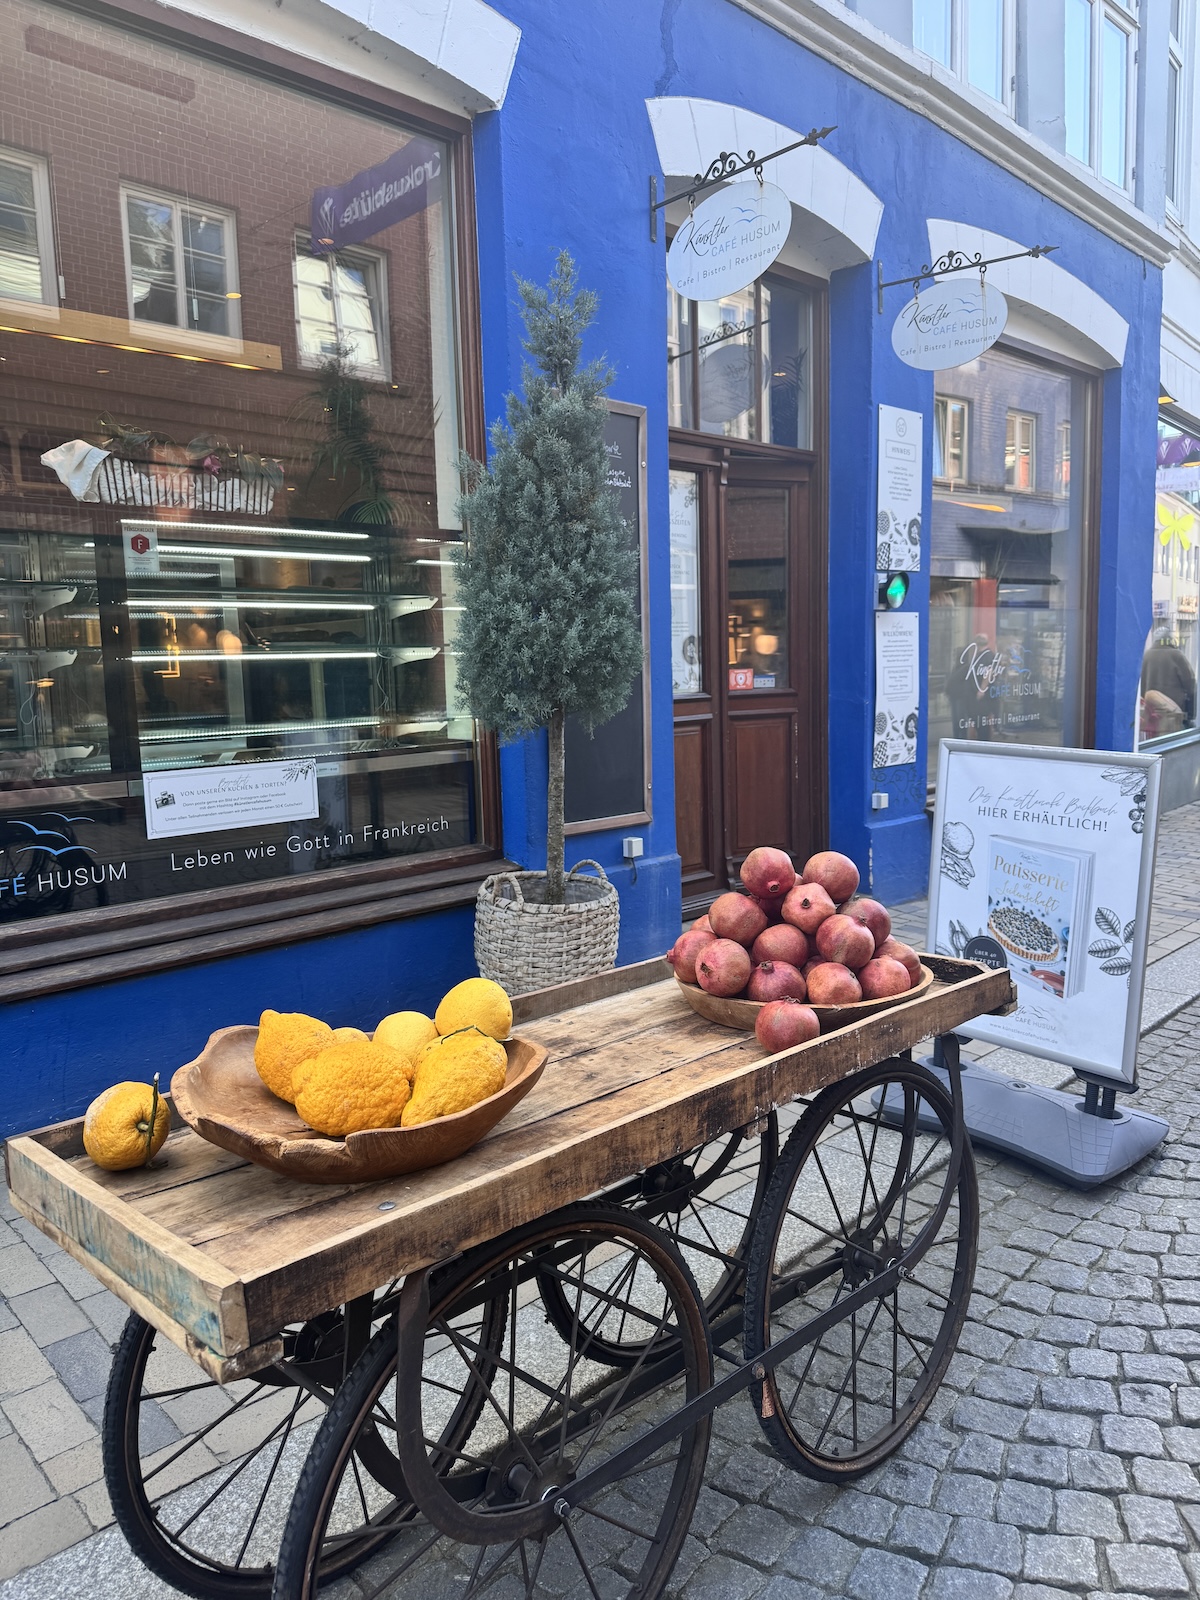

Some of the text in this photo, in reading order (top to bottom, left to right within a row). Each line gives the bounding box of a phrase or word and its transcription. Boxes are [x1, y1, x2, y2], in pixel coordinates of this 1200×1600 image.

[676, 216, 730, 257] Künstler
[711, 220, 781, 257] CAFÉ HUSUM
[676, 243, 780, 289] Cafe Bistro Restaurant
[902, 302, 951, 333] Künstler
[933, 316, 998, 336] CAFÉ HUSUM
[900, 334, 996, 356] Cafe Bistro Restaurant
[137, 539, 143, 549] F
[960, 642, 1006, 693] Künstler
[1012, 683, 1040, 696] HUSUM
[959, 712, 1040, 729] Cafe Bistro Restaurant
[978, 806, 1107, 832] HIER ERHÄLTLICH!
[171, 816, 449, 871] Leben wie Gott in Frankreich
[0, 861, 128, 898] FÉ HUSUM
[994, 855, 1069, 892] Patisserie
[995, 880, 1060, 913] Leidenschaft
[974, 948, 988, 956] ÜBER
[1015, 1016, 1056, 1031] CAFÉ HUSUM
